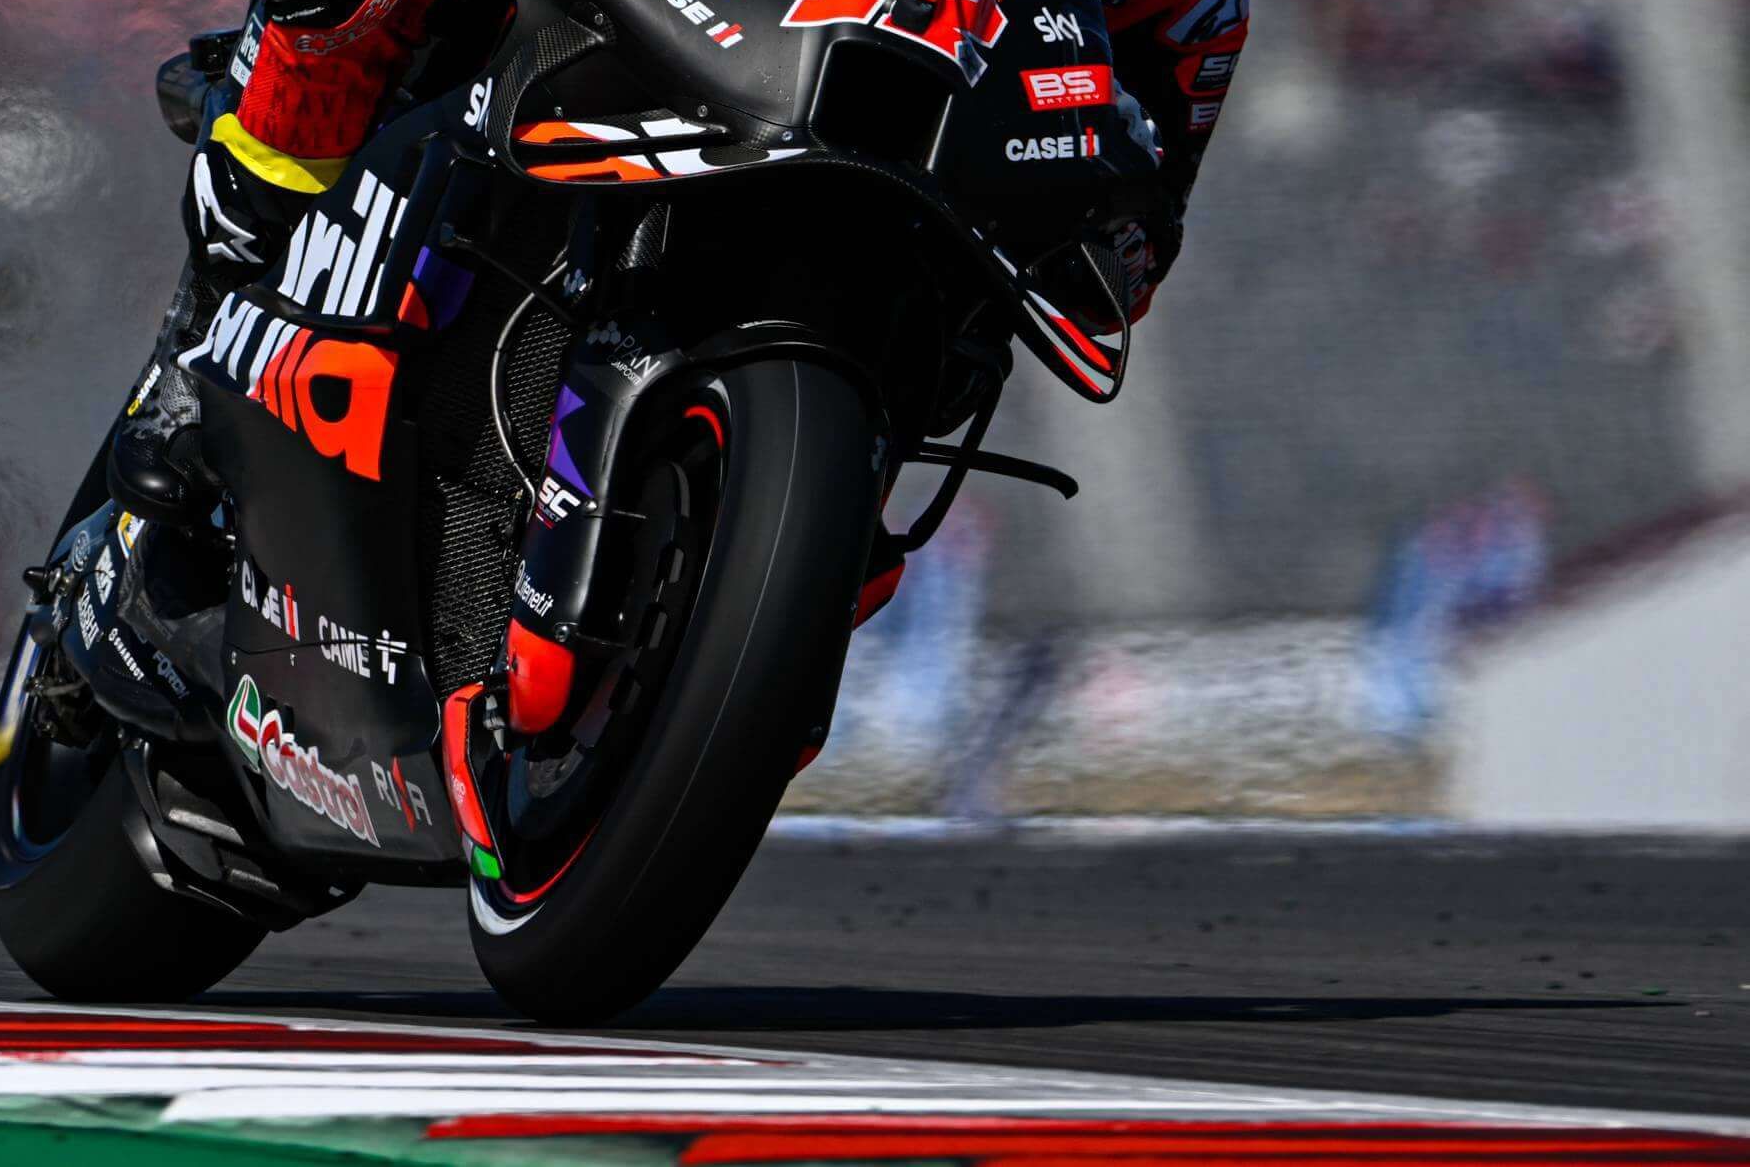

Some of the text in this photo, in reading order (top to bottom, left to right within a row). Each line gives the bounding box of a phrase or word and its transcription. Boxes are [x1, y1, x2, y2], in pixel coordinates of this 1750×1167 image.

[1033, 6, 1085, 48] sky
[1029, 70, 1097, 98] BS
[1005, 136, 1075, 161] CASE
[539, 476, 581, 518] SC
[318, 615, 371, 679] CAME
[260, 709, 382, 849] Castrol
